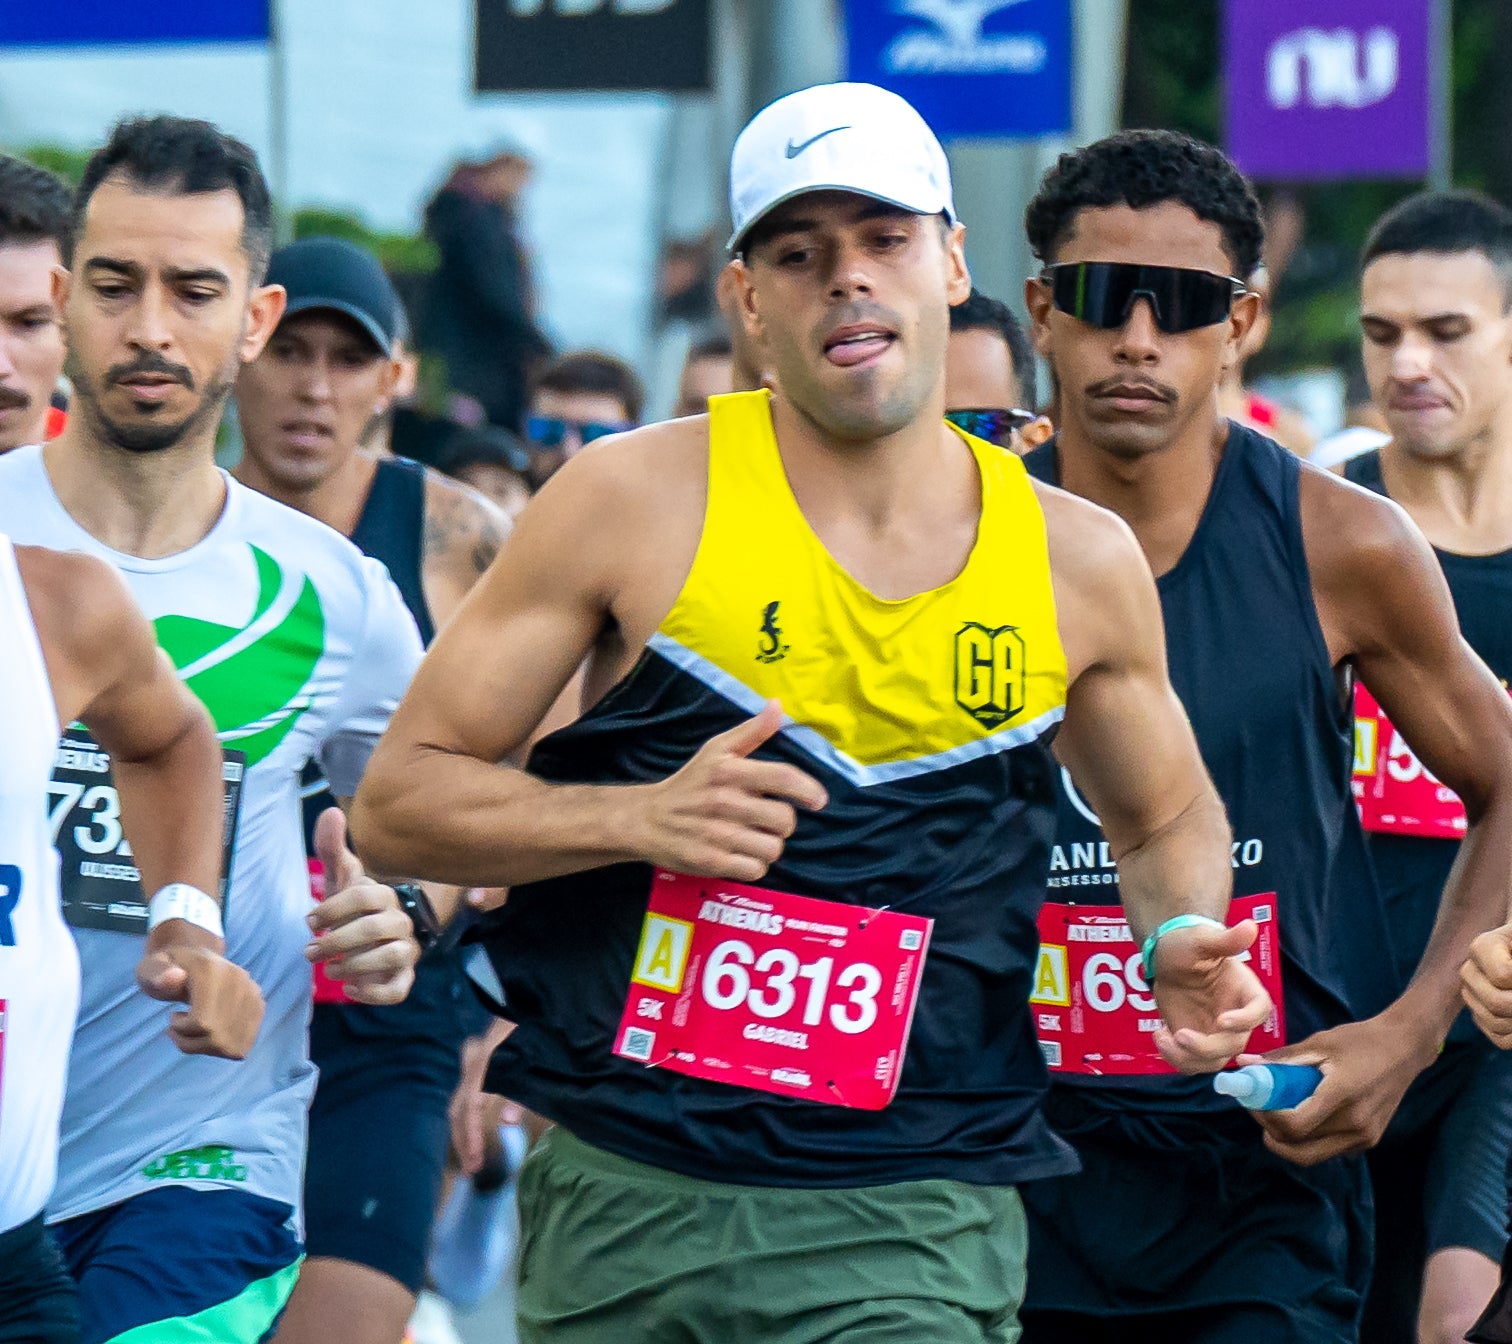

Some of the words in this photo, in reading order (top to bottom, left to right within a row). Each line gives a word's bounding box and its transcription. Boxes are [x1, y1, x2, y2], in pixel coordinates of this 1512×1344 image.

[647, 927, 672, 979] A
[1036, 952, 1059, 997] A
[701, 939, 883, 1034] 6313
